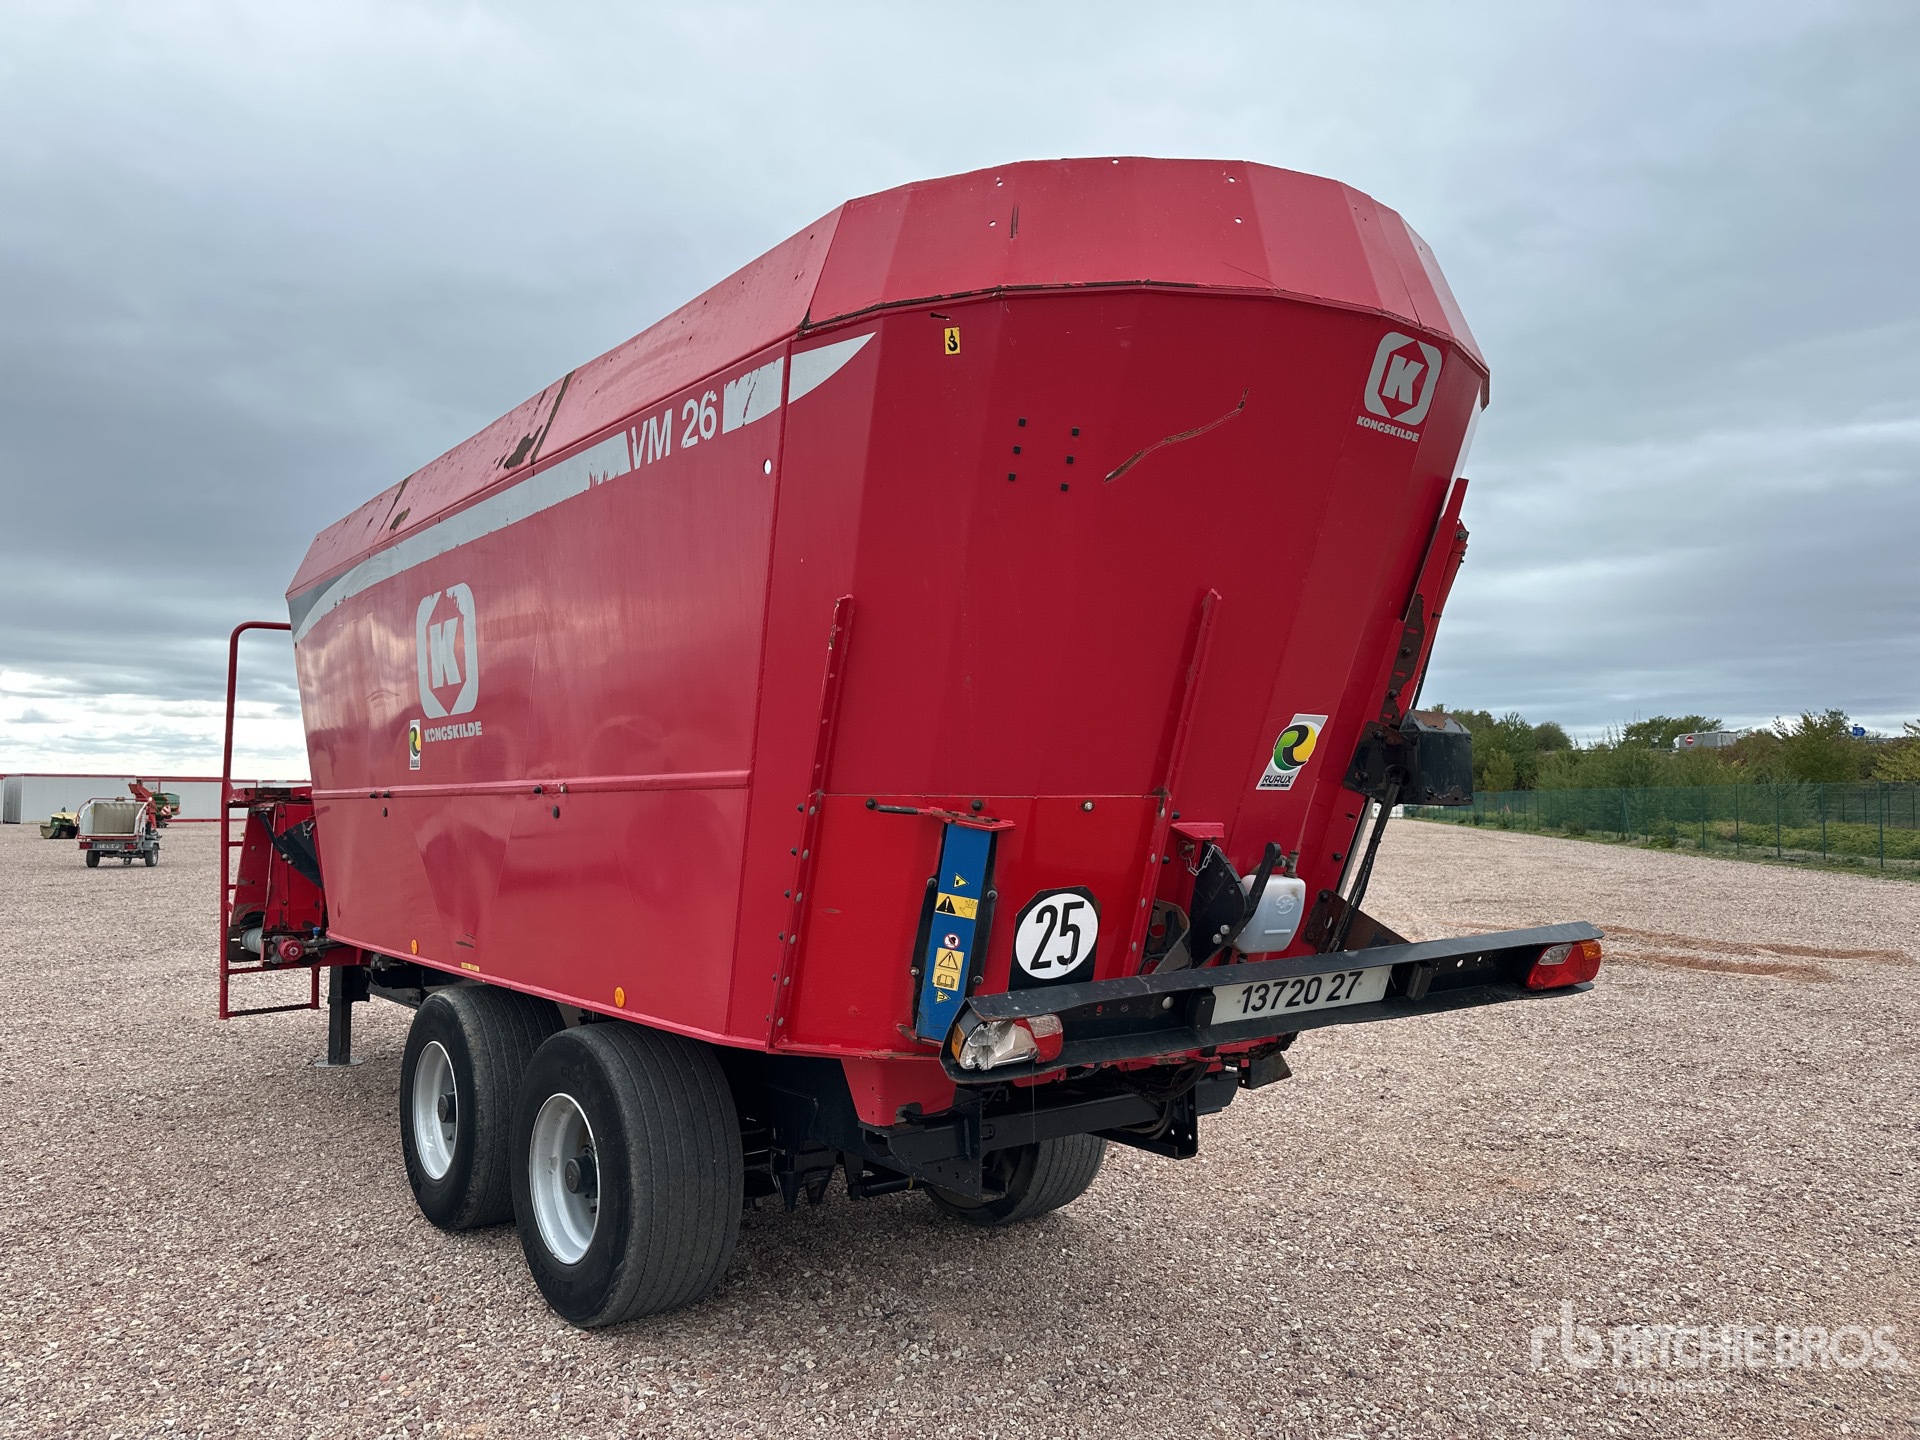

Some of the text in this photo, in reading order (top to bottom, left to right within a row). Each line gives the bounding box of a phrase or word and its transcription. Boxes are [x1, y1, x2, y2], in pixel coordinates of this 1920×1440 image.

[631, 390, 718, 470] VM 26
[1356, 415, 1420, 442] KONGSKILDE
[424, 721, 483, 743] KONGSKILDE
[1261, 775, 1294, 784] RUAUX
[1029, 901, 1085, 971] 25
[1241, 970, 1364, 1014] 13720 27
